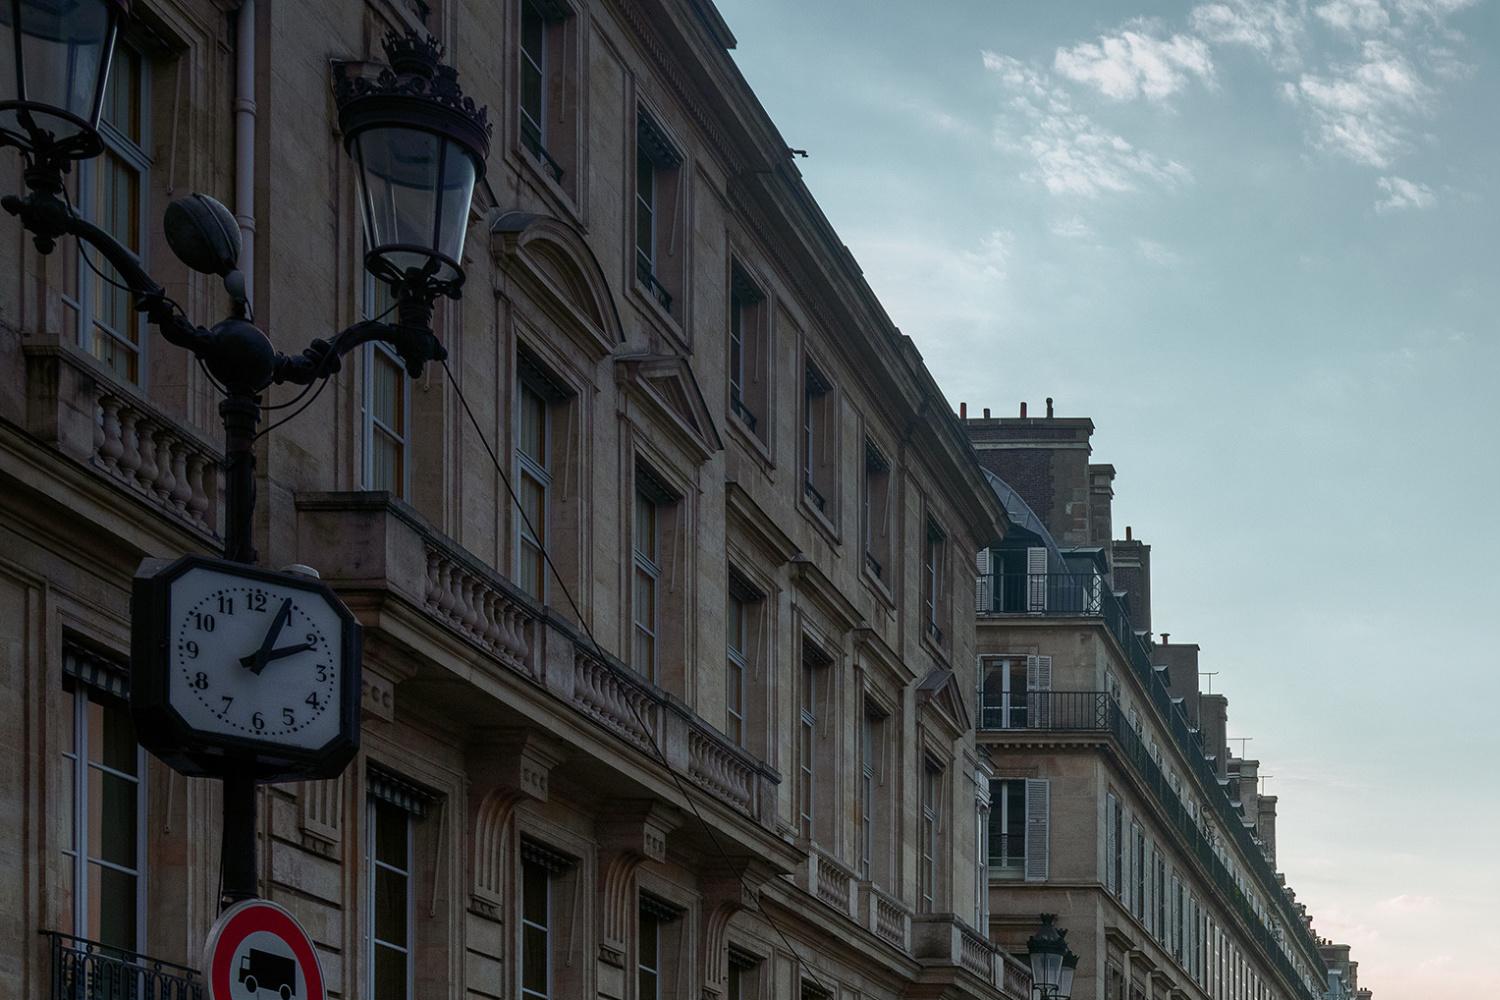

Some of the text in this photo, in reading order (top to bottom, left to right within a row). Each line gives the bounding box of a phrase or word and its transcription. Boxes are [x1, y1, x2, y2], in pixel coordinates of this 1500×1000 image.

[218, 596, 234, 615] 11
[246, 593, 267, 612] 12
[194, 613, 215, 633] 10
[186, 641, 199, 659] 9
[306, 633, 318, 652] 2
[195, 672, 209, 690] 8
[316, 664, 327, 682] 3
[221, 696, 234, 714] 7
[305, 692, 320, 710] 4
[252, 712, 265, 730] 6
[282, 708, 295, 726] 5
